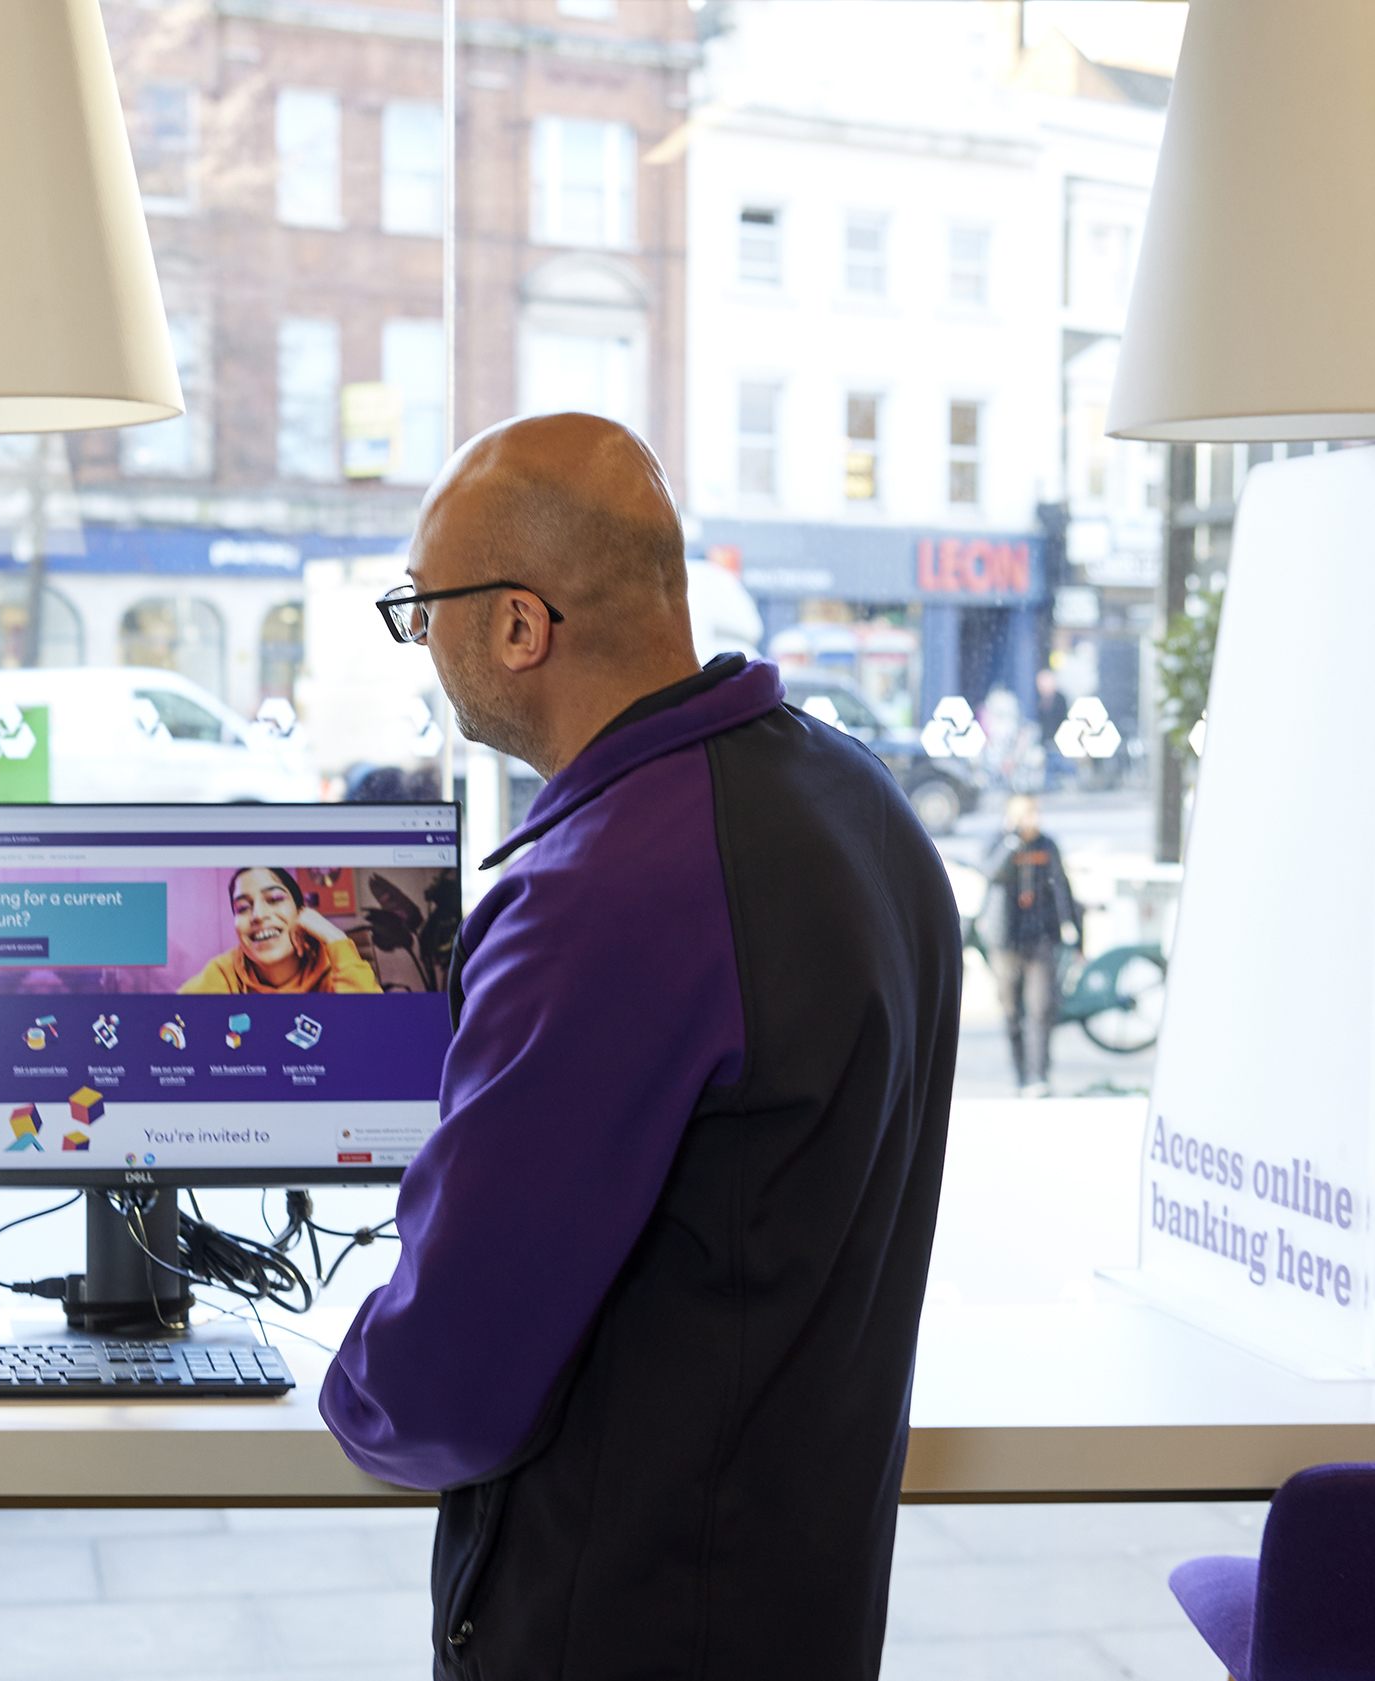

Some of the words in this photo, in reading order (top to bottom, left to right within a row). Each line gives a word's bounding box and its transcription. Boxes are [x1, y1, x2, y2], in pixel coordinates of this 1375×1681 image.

[917, 537, 1030, 594] LEON
[24, 889, 47, 906] for
[50, 893, 60, 906] a
[64, 891, 123, 906] current
[17, 943, 43, 951] accounts
[143, 1128, 195, 1143] You're
[198, 1128, 251, 1143] invited
[254, 1128, 270, 1143] to
[125, 1172, 155, 1183] DELL
[1150, 1115, 1244, 1191] Access
[1253, 1157, 1353, 1230] online
[1151, 1180, 1269, 1287] banking
[1276, 1226, 1352, 1307] here
